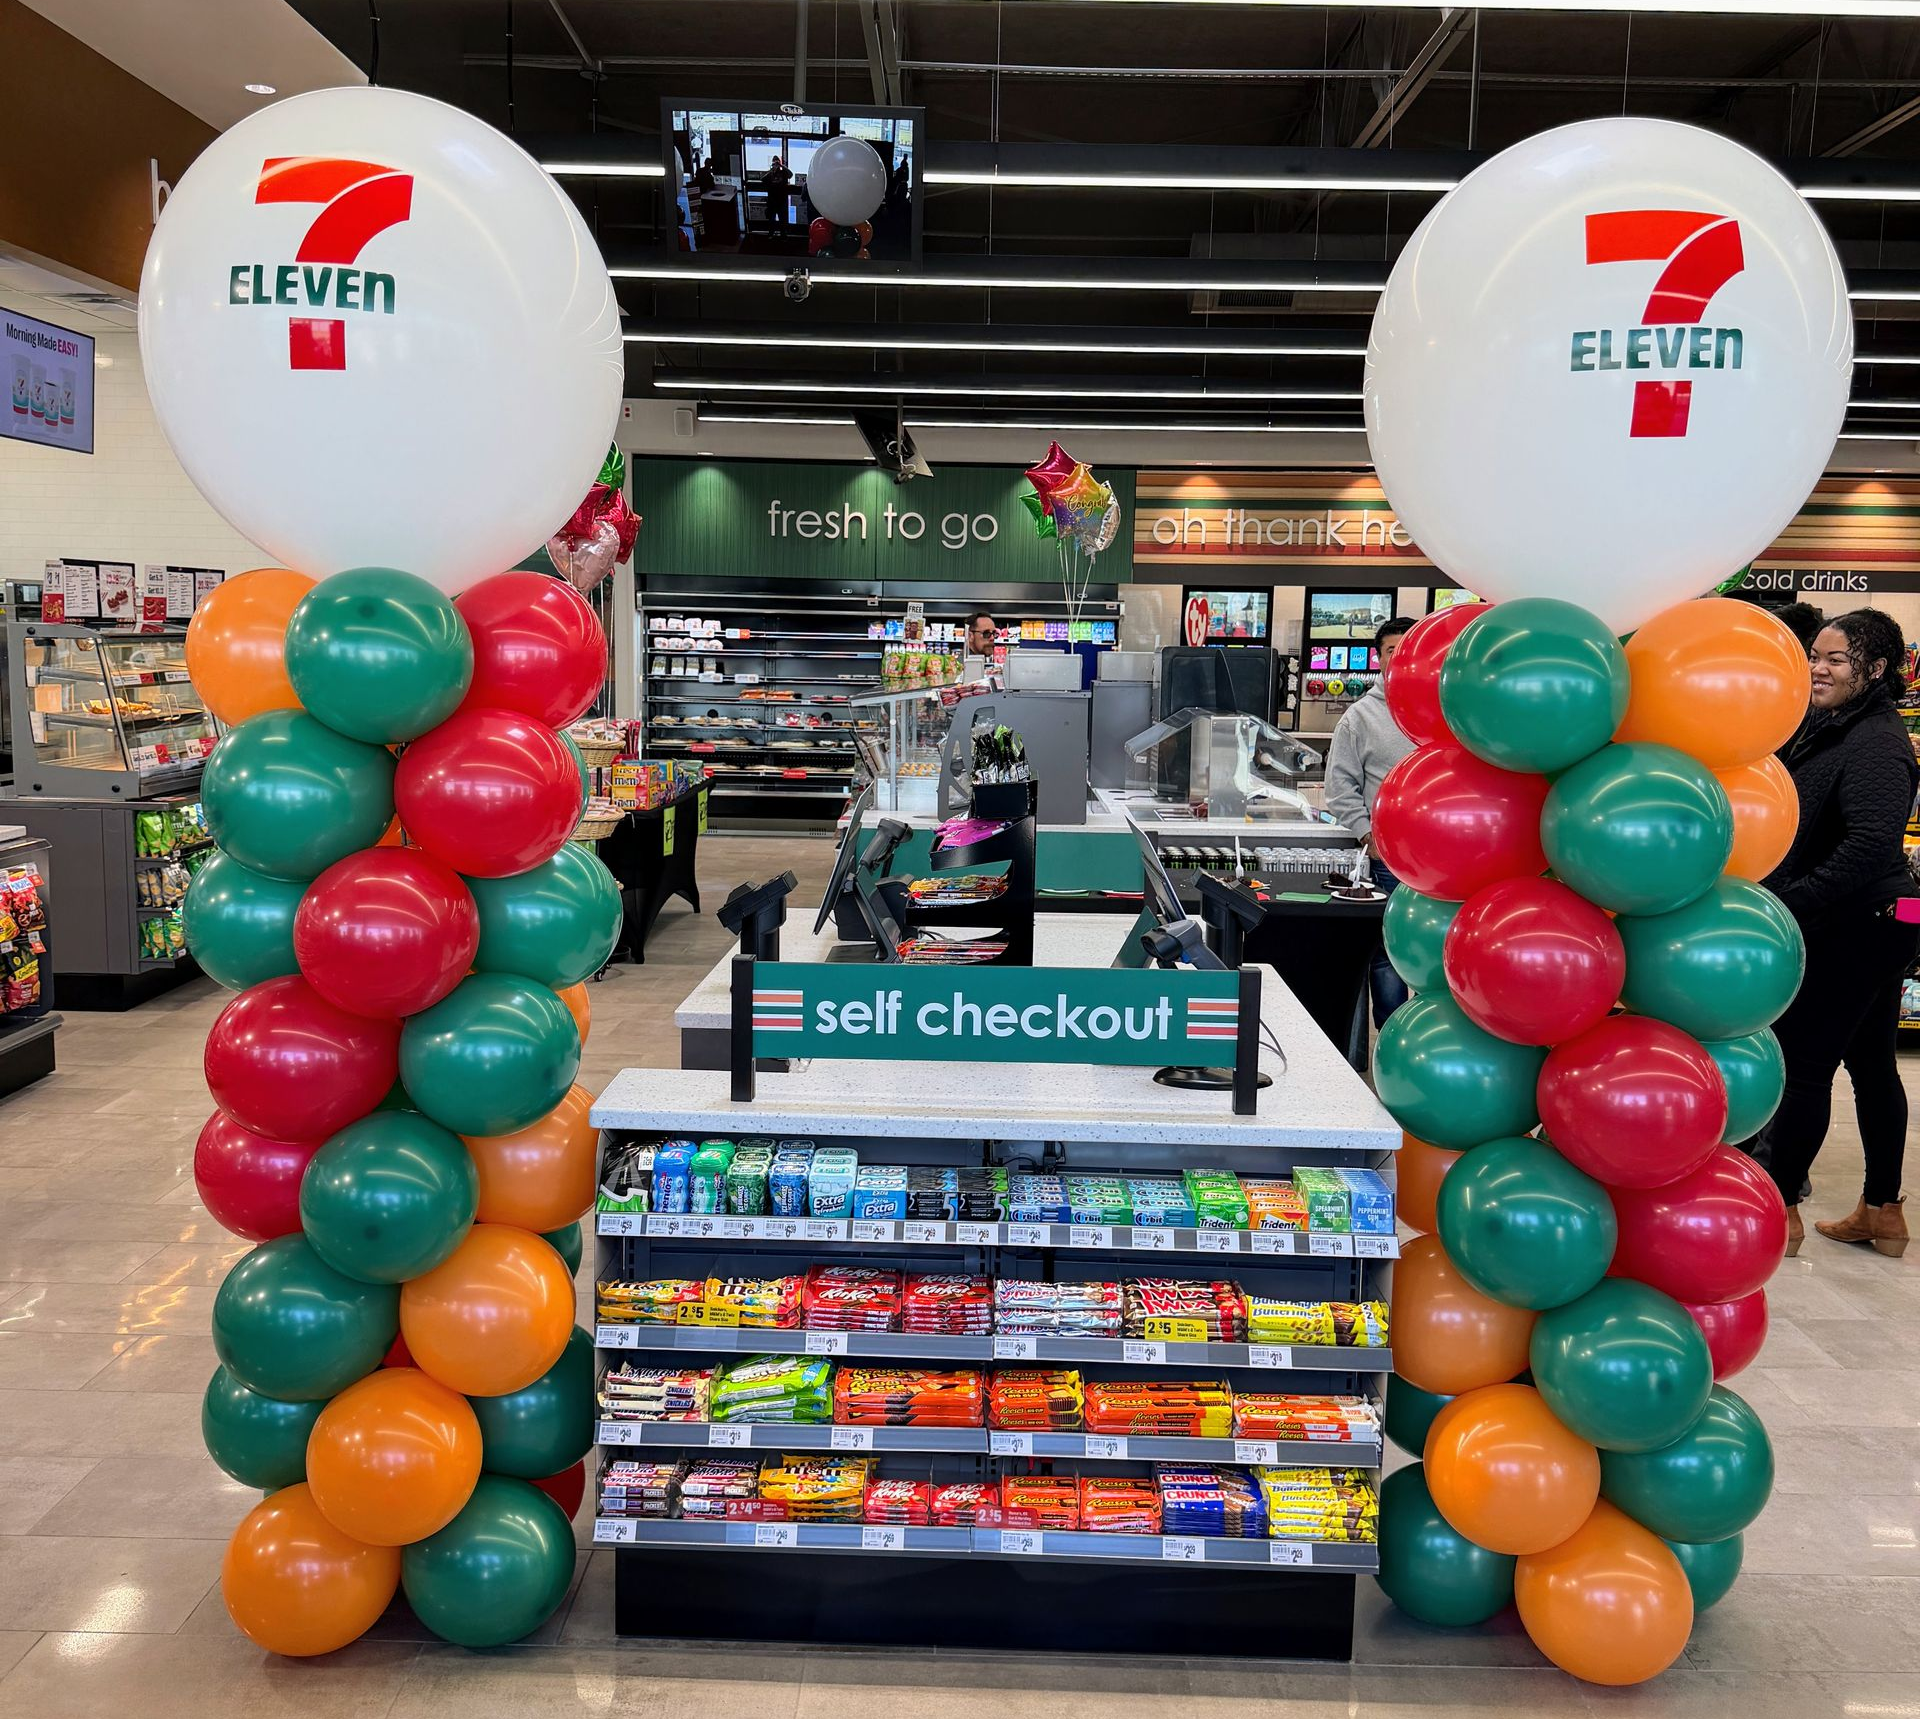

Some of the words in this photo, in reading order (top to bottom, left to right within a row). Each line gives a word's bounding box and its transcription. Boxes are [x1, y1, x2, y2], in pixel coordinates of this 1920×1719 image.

[255, 157, 414, 370] 7
[1585, 210, 1744, 437] 7
[6, 322, 37, 348] Morning
[37, 332, 57, 352] Made
[58, 338, 79, 358] EASY!
[768, 500, 867, 539] fresh
[883, 503, 926, 540] to
[941, 513, 998, 549] go
[1152, 508, 1206, 545] oh
[1223, 508, 1347, 546] thank
[1740, 570, 1794, 591] cold
[1801, 570, 1868, 592] drinks
[908, 605, 922, 613] FREE
[815, 989, 903, 1035] self
[916, 991, 1174, 1041] checkout
[814, 1195, 845, 1209] Extra
[865, 1202, 896, 1217] Extra
[1358, 1207, 1389, 1215] PEPPERMINT
[1200, 1218, 1235, 1229] Trident
[1260, 1219, 1296, 1230] Trident
[680, 1306, 689, 1318] 2
[692, 1306, 704, 1319] $5
[1148, 1322, 1156, 1334] 2
[1159, 1321, 1172, 1334] $5
[1240, 1405, 1295, 1416] Reese's
[1162, 1475, 1220, 1484] CRUNCH
[1166, 1490, 1225, 1500] CRUNCH
[730, 1502, 738, 1515] 2
[978, 1508, 986, 1522] 2
